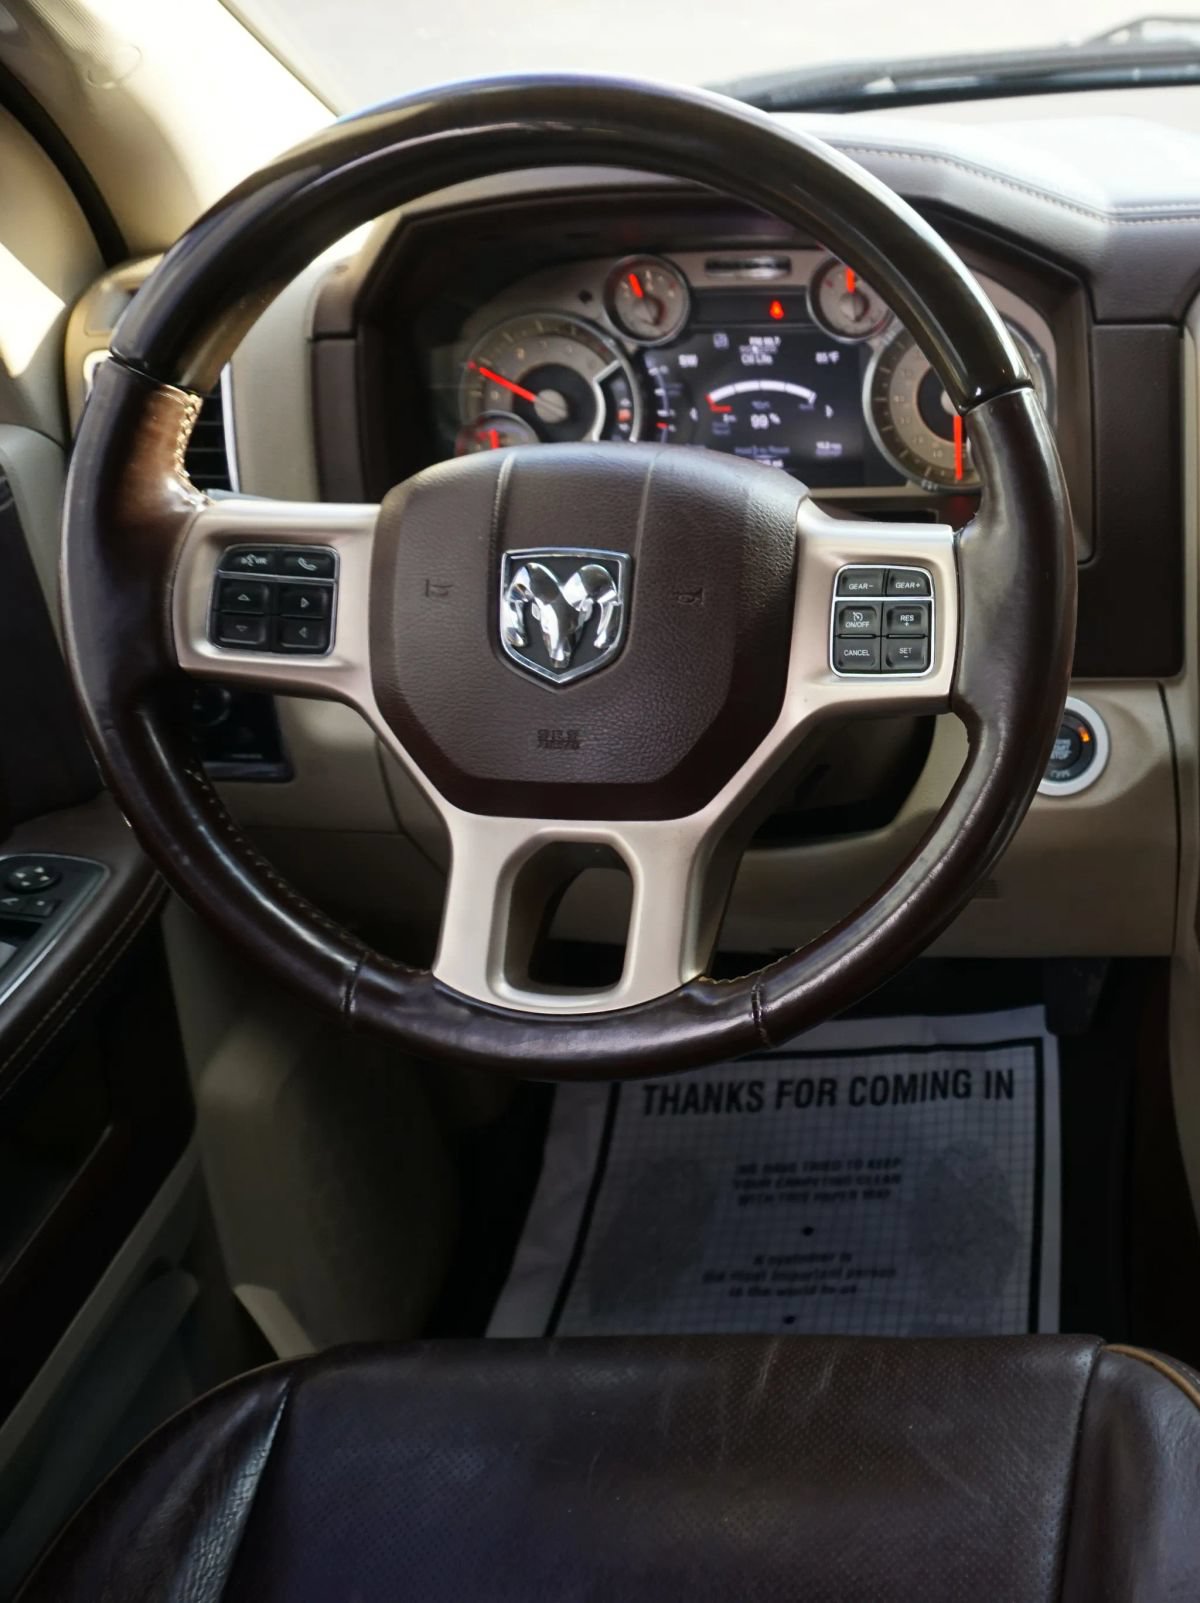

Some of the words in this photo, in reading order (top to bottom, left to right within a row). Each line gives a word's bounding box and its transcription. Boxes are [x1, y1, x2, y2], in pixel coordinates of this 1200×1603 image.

[642, 1080, 766, 1116] THANKS
[774, 1076, 839, 1110] FOR
[848, 1069, 973, 1106] COMING
[985, 1069, 1015, 1100] IN
